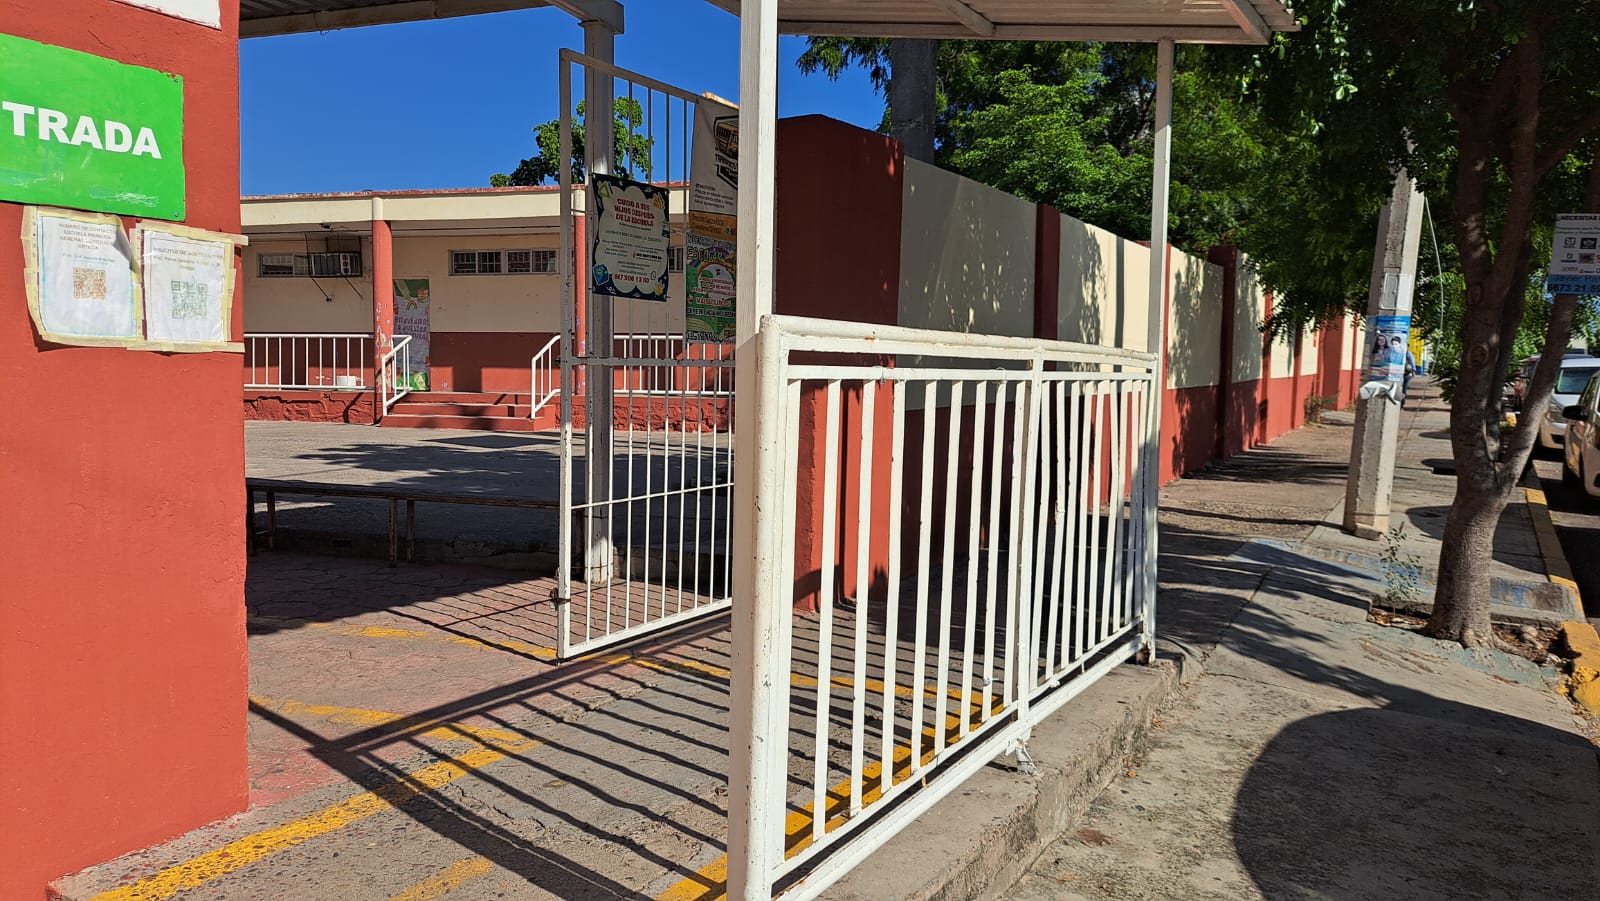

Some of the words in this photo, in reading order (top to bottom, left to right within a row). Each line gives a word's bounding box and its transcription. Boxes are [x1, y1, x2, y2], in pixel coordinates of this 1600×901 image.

[2, 100, 162, 160] TRADA
[617, 198, 635, 208] CUIDO
[635, 201, 641, 209] A
[614, 205, 632, 214] HIJOS
[631, 217, 654, 227] ESCUELA
